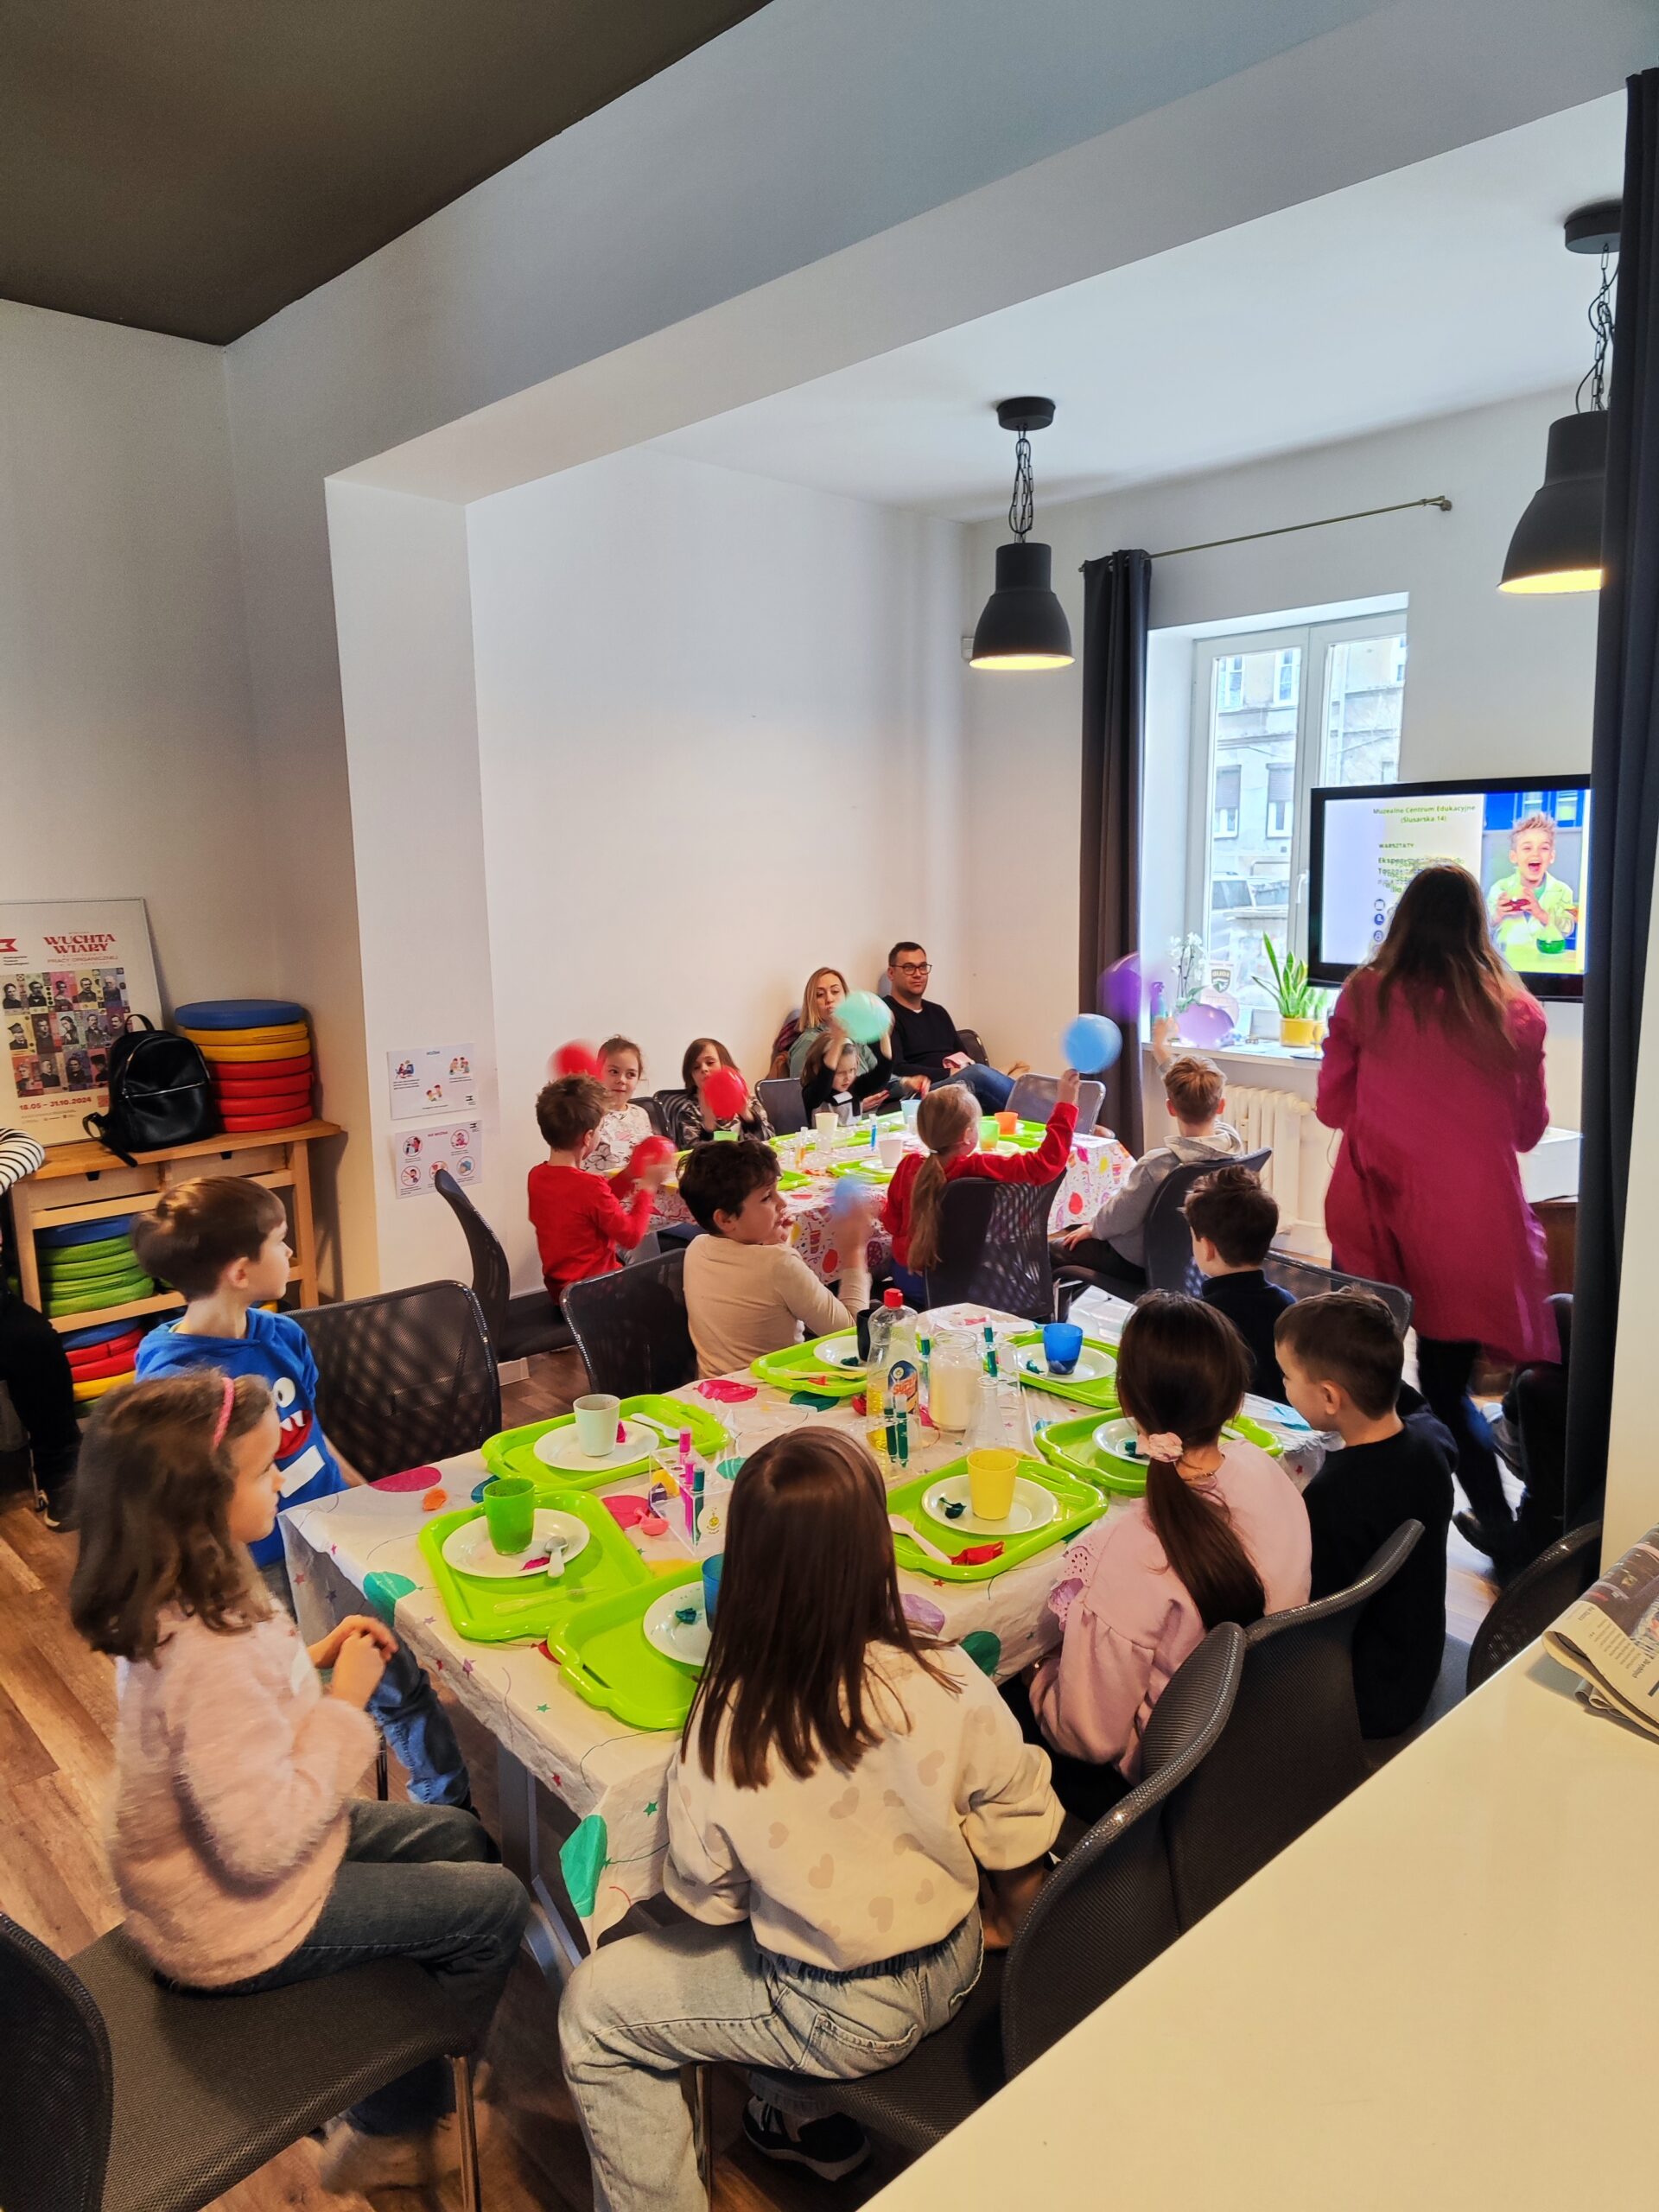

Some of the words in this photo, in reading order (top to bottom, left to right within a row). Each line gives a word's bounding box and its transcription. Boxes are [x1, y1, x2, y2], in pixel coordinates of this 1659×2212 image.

[1436, 804, 1476, 813] Edukacyjne
[43, 934, 116, 945] WUCHTA
[53, 944, 108, 954] WIARY
